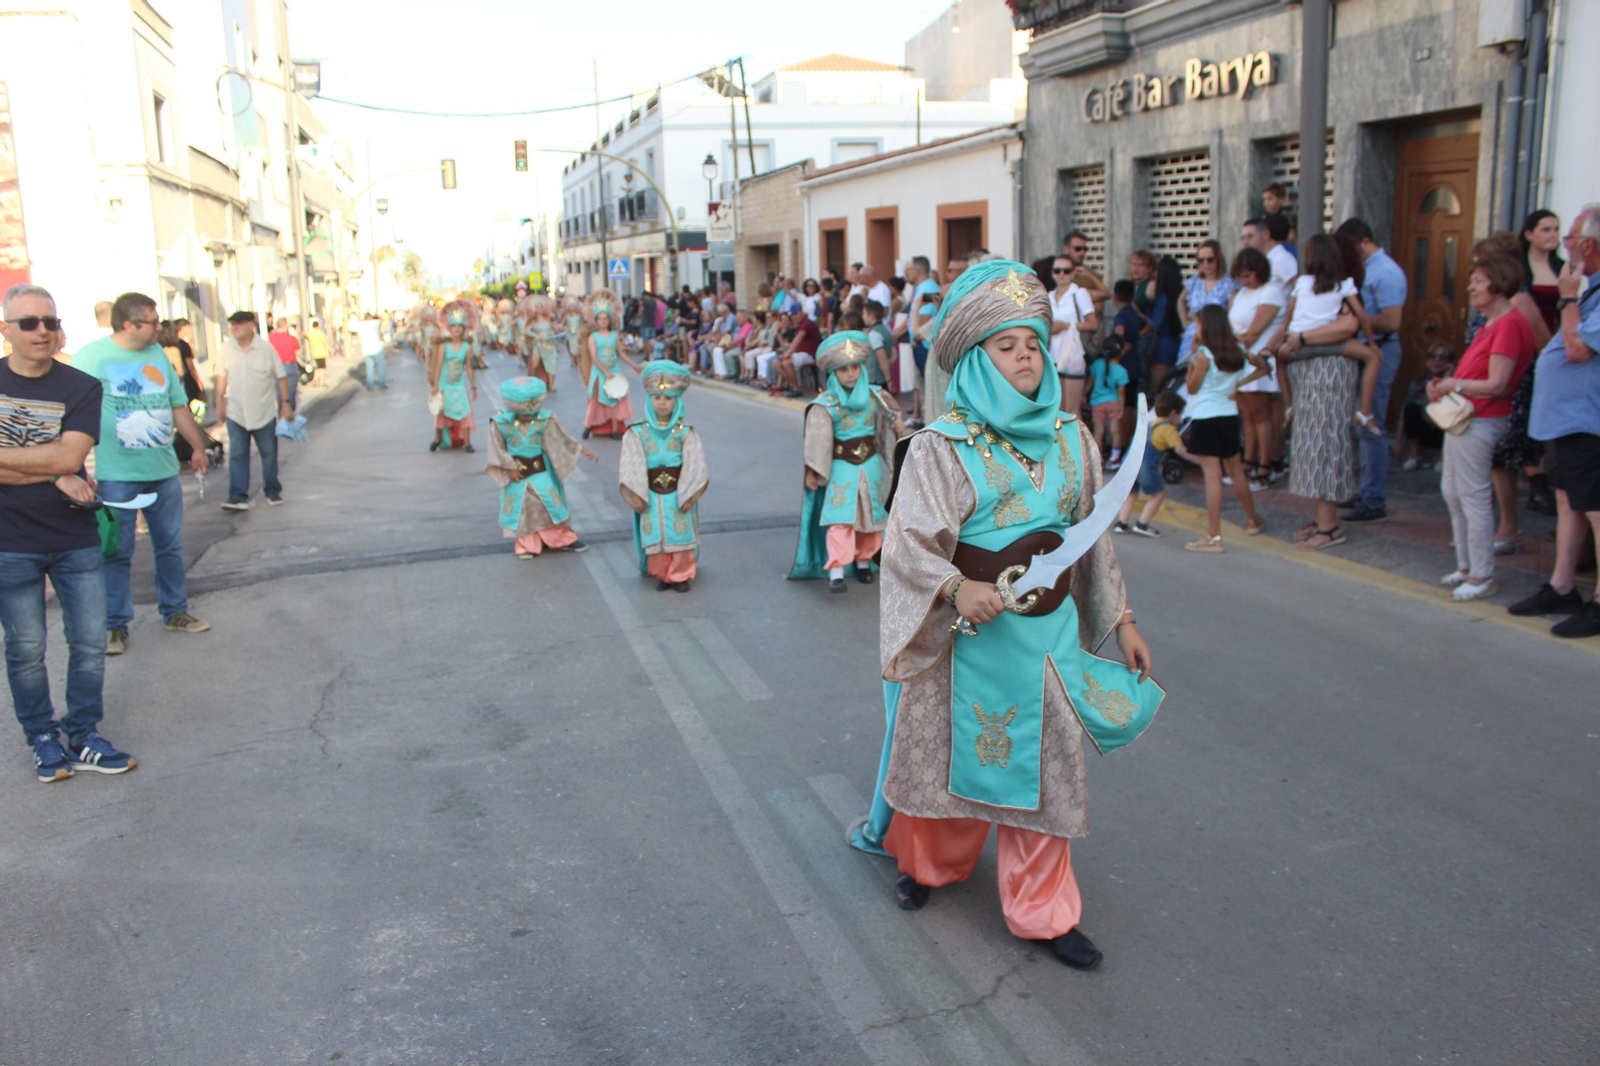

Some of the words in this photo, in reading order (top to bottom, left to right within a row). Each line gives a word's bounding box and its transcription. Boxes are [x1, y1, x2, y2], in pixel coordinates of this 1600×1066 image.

[1082, 79, 1126, 122] Café
[1133, 72, 1178, 112] Bar
[1185, 50, 1273, 100] Barya
